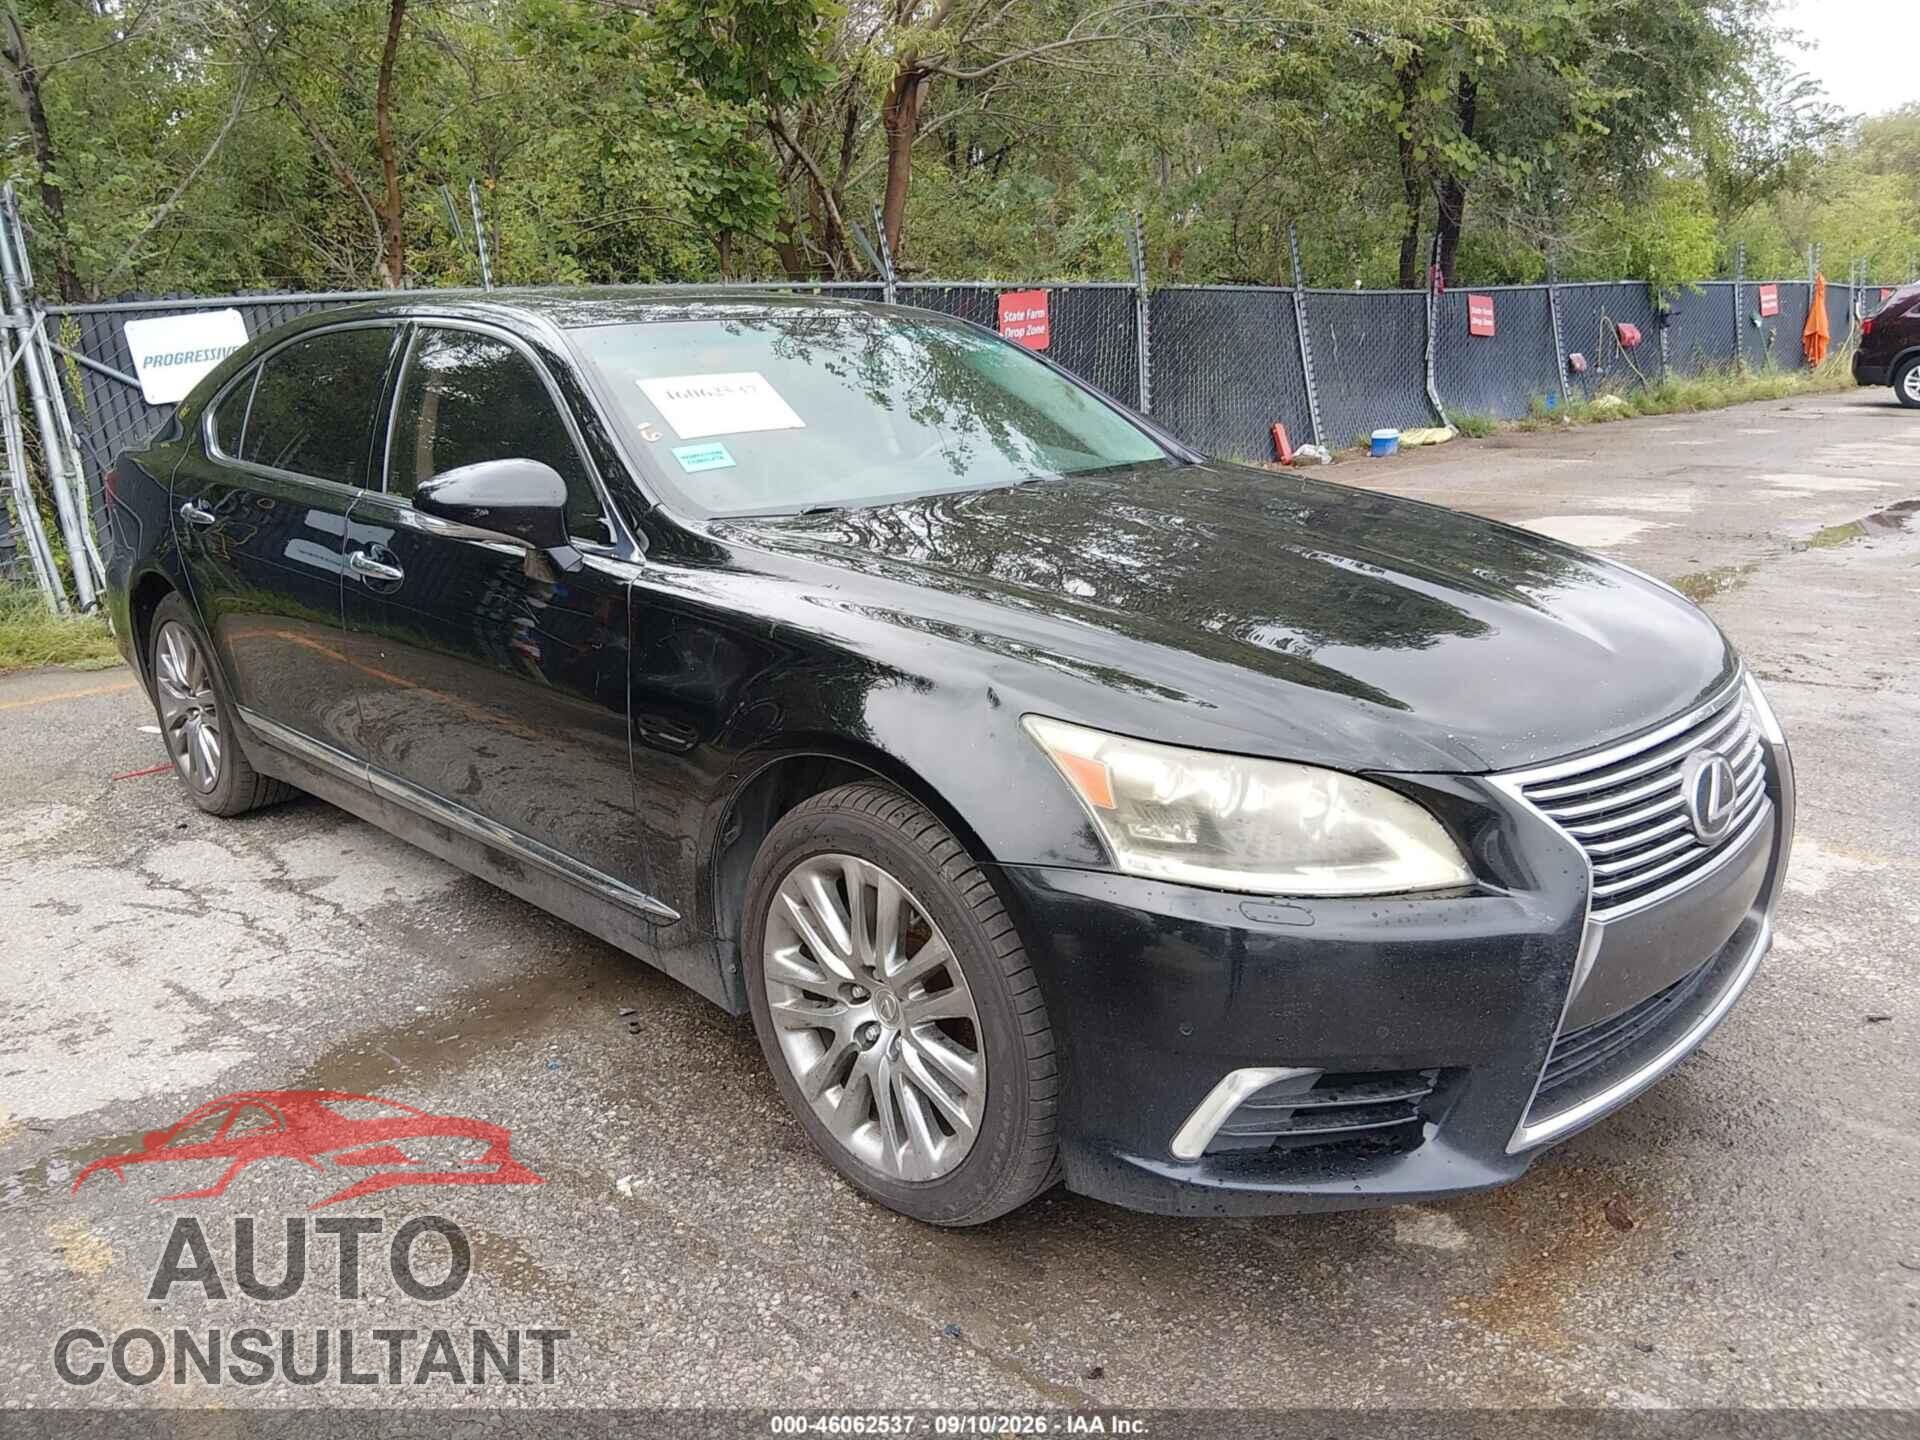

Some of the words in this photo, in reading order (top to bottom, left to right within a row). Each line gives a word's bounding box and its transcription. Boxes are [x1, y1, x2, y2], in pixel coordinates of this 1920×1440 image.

[1003, 310, 1025, 323] State
[1026, 308, 1045, 320] Farm
[1005, 326, 1025, 340] Drop
[1026, 324, 1046, 336] Zone
